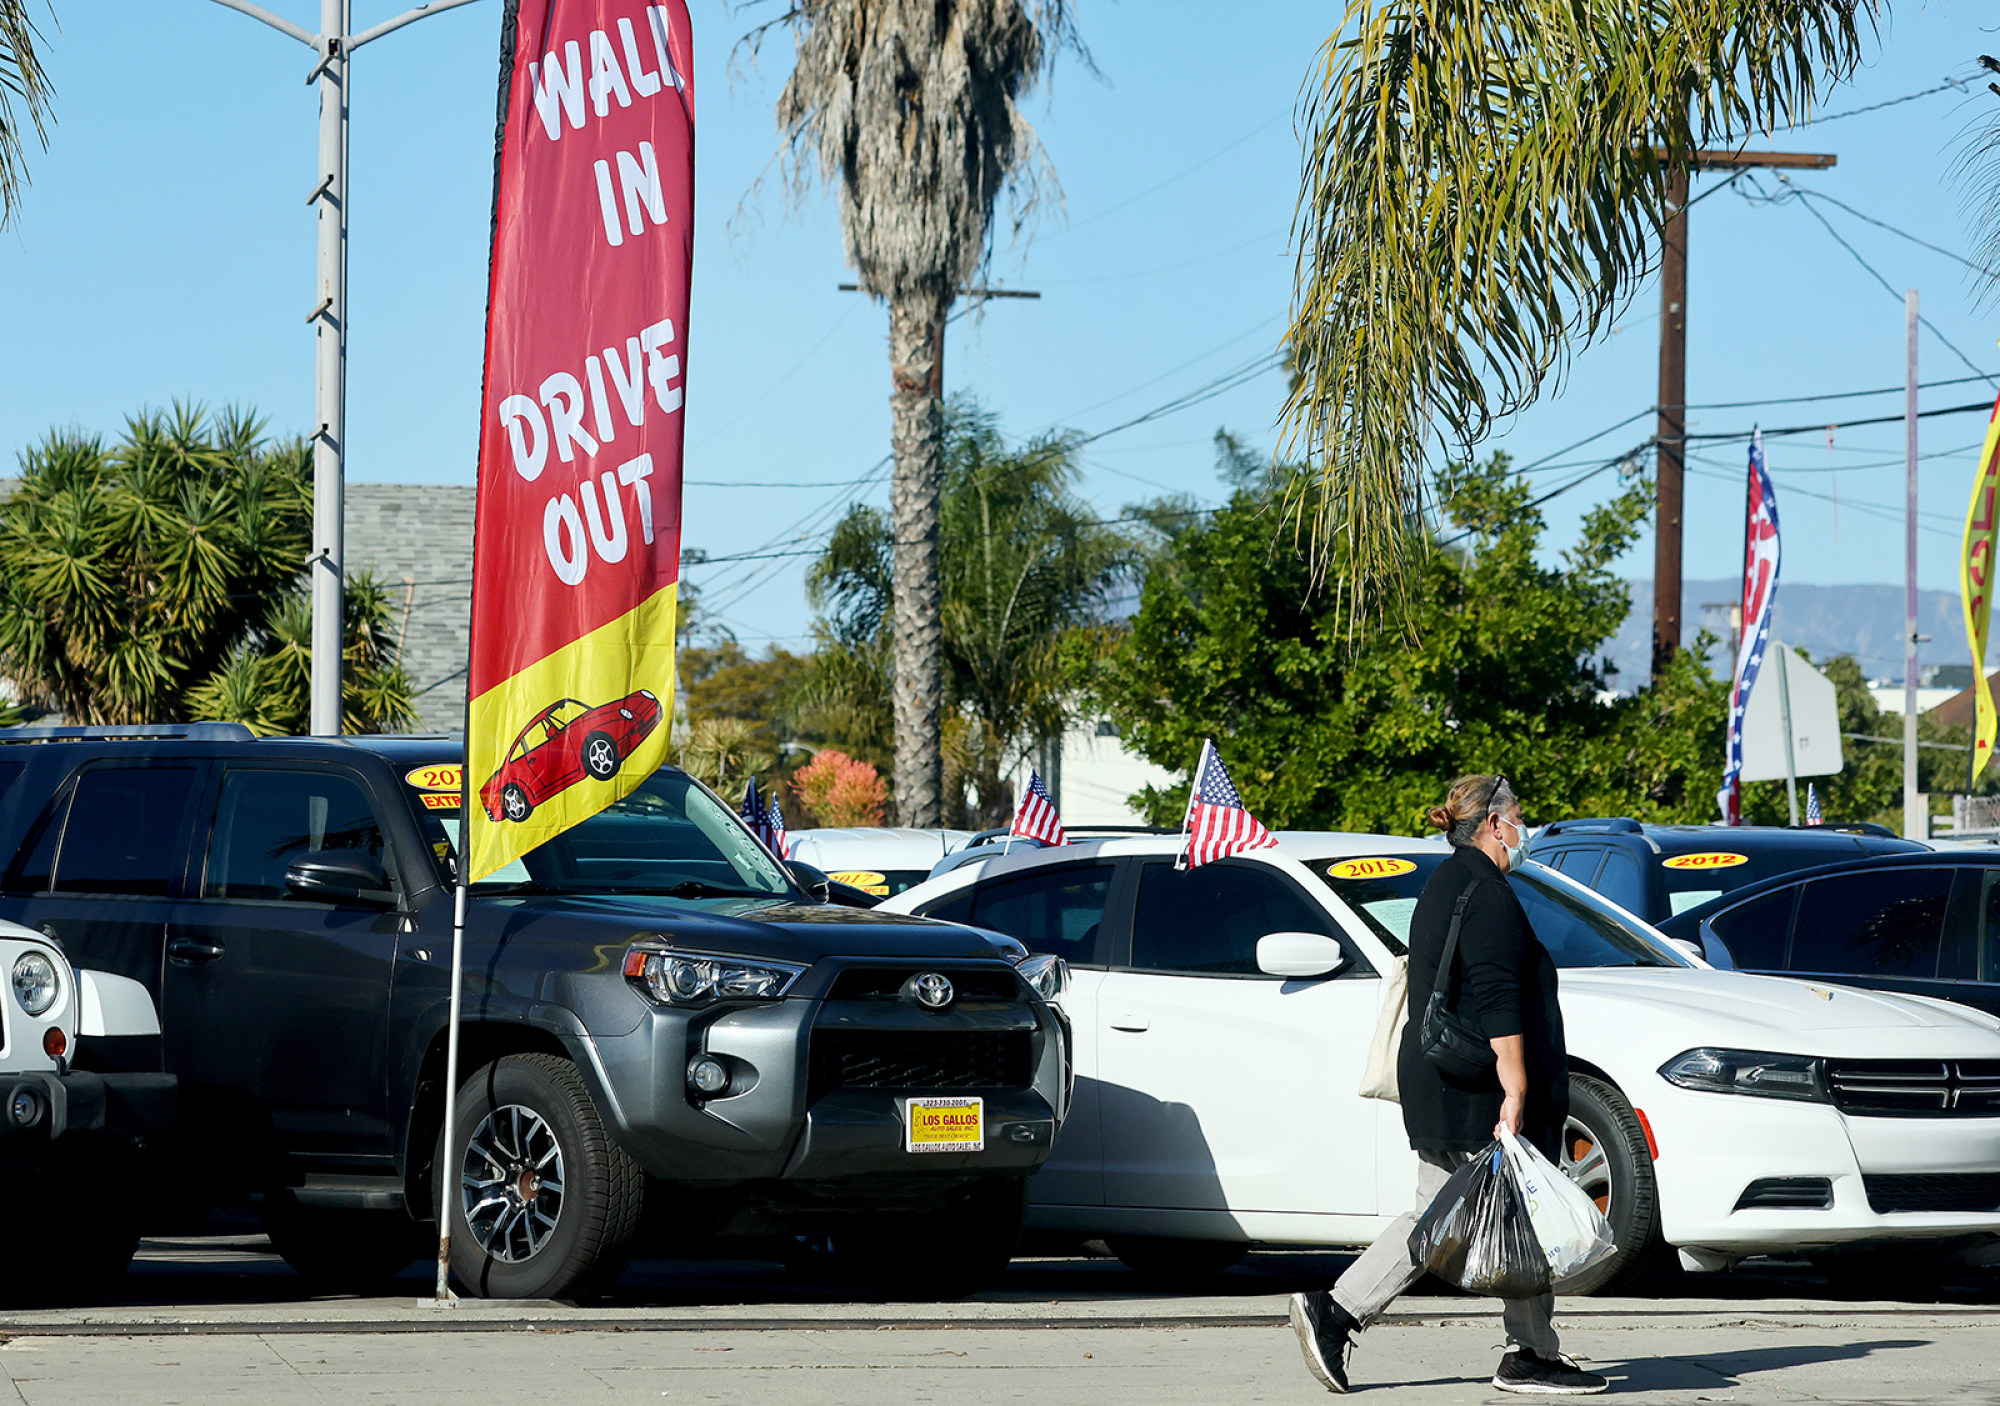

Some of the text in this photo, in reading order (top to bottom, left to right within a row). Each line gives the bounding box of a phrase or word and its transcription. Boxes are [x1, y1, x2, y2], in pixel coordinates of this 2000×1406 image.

[593, 140, 669, 246] IN
[499, 318, 683, 482] DRIVE
[543, 452, 655, 586] OUT
[423, 769, 463, 787] 201
[423, 795, 462, 807] EXTR
[1345, 859, 1401, 877] 2015
[1675, 855, 1736, 867] 2012
[923, 1114, 979, 1126] LOS GALLOS
